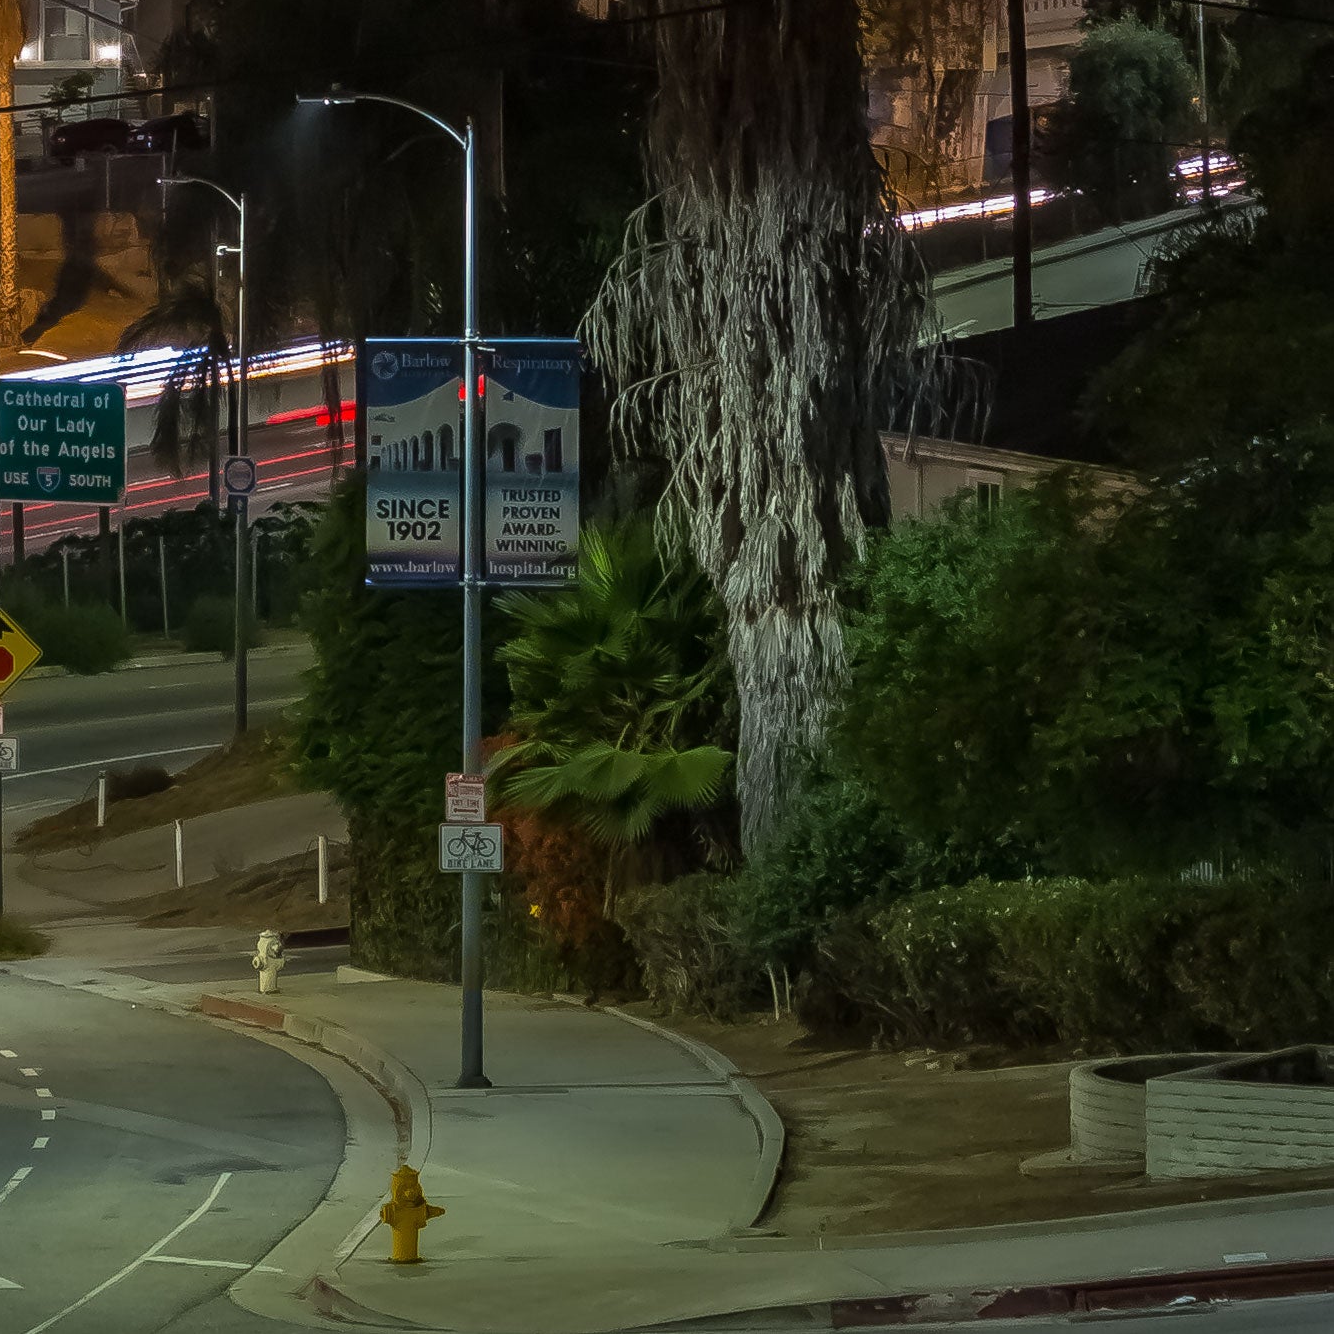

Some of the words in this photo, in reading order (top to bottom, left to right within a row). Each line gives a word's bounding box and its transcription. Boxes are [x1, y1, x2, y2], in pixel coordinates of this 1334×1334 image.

[402, 353, 452, 367] Barlow
[3, 390, 85, 409] Cathedral
[94, 393, 109, 409] of
[18, 415, 47, 432] Our
[56, 416, 96, 438] Lady
[0, 440, 15, 455] of
[23, 441, 50, 457] the
[58, 441, 115, 463] Angels
[4, 472, 29, 485] USE
[45, 474, 53, 487] 5
[69, 474, 112, 488] SOUTH
[501, 489, 561, 502] TRUSTED
[376, 499, 450, 519] SINCE
[502, 507, 560, 519] PROVEN
[386, 521, 442, 541] 1902
[501, 523, 561, 536] AWARD-
[495, 539, 567, 553] WINNING
[369, 560, 456, 573] www.barlow
[489, 560, 576, 580] hospital.org
[470, 858, 495, 869] LANE
